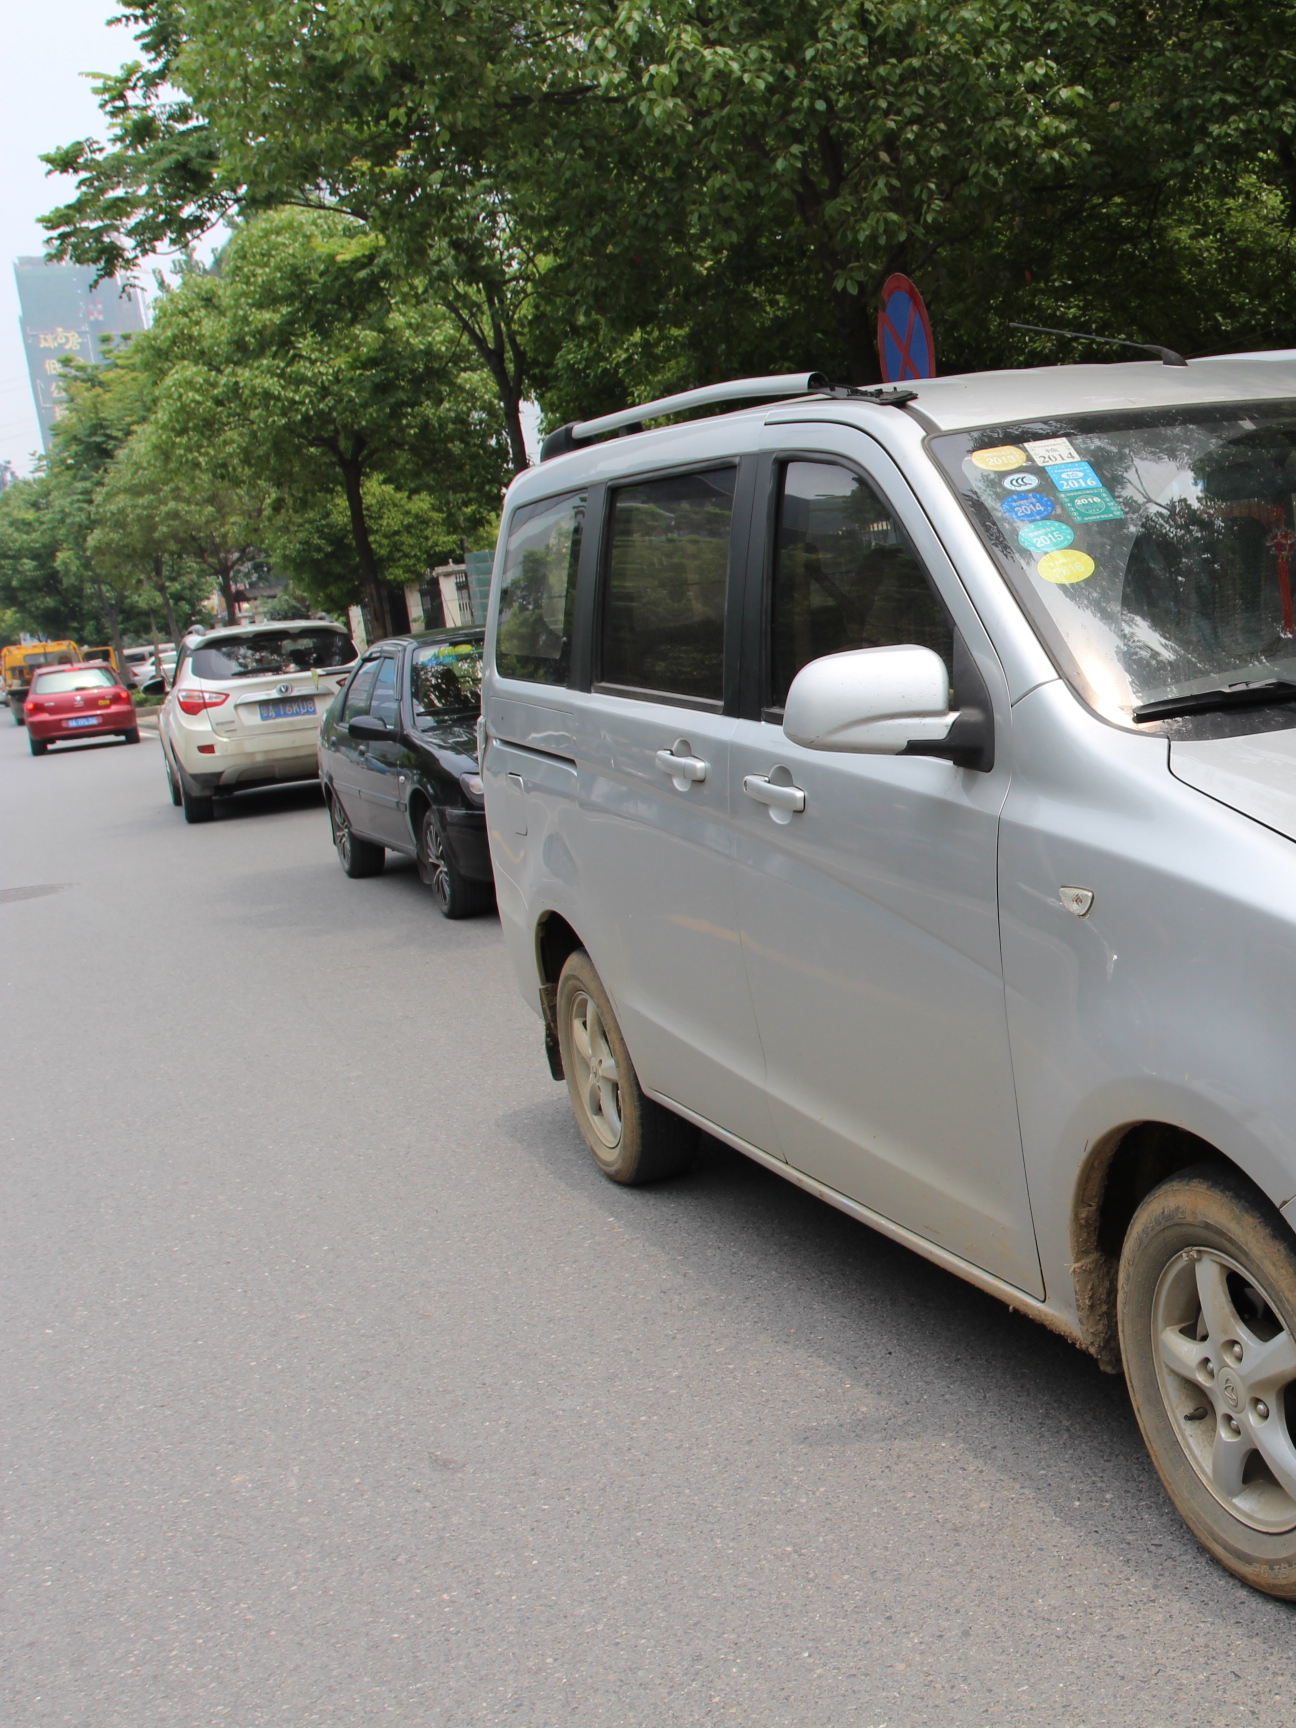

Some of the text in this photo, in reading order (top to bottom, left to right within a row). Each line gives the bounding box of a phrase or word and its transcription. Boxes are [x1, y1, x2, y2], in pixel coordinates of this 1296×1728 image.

[986, 455, 1017, 466] 2013
[1039, 451, 1076, 465] 2014
[1010, 475, 1033, 488] CCC
[1059, 477, 1097, 490] 2016
[1075, 496, 1101, 505] 2016
[1014, 502, 1045, 517] 2014
[1033, 531, 1065, 547] 2015
[1053, 563, 1085, 578] 2016
